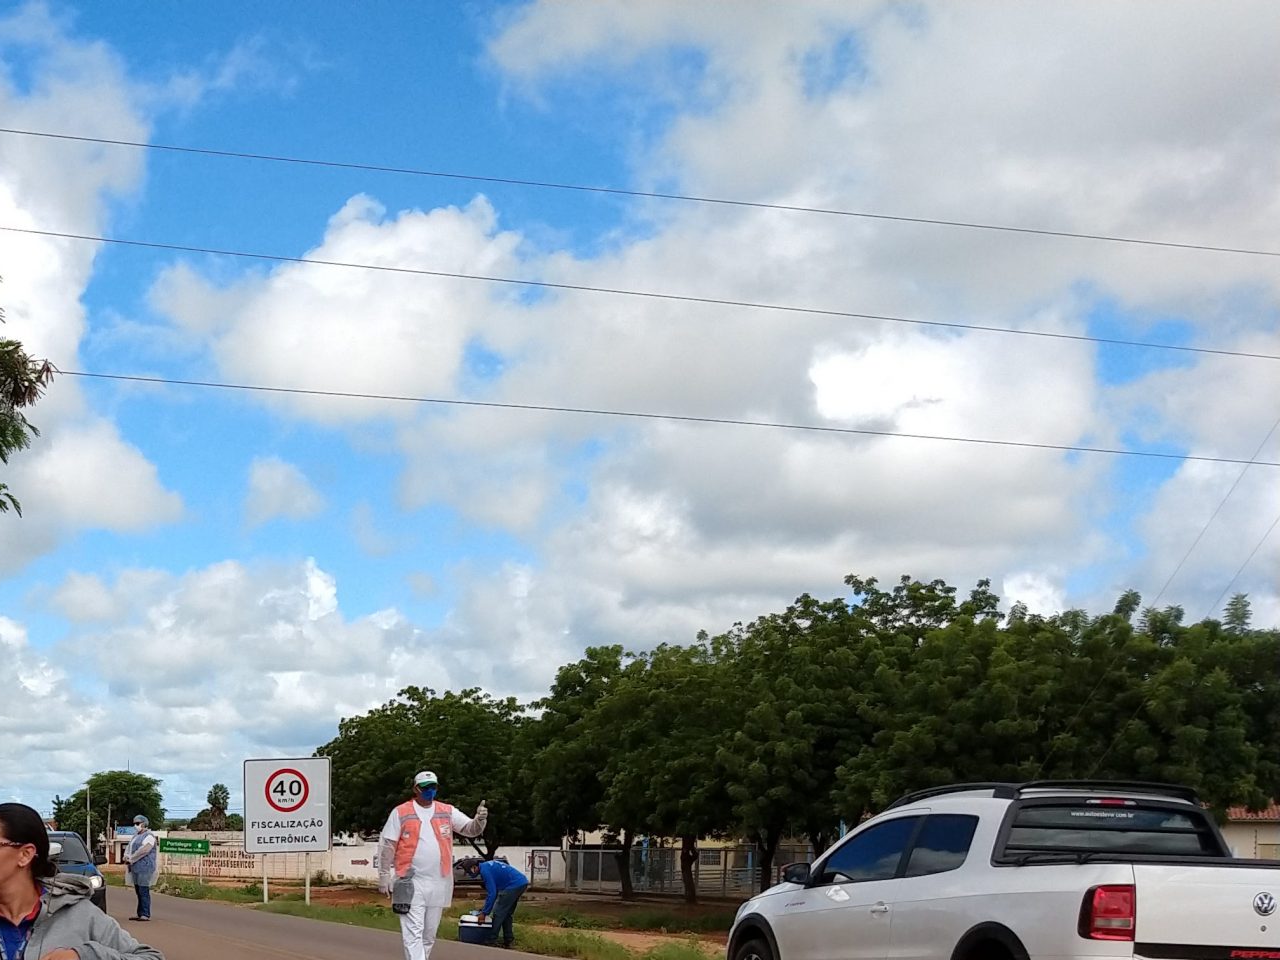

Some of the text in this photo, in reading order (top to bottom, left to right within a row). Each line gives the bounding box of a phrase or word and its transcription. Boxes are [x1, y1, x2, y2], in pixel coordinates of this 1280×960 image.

[272, 780, 302, 796] 40
[251, 818, 324, 829] FISCALIZAÇÃO
[257, 834, 317, 844] ELETRÔNICA
[1231, 950, 1280, 959] PEPPE
